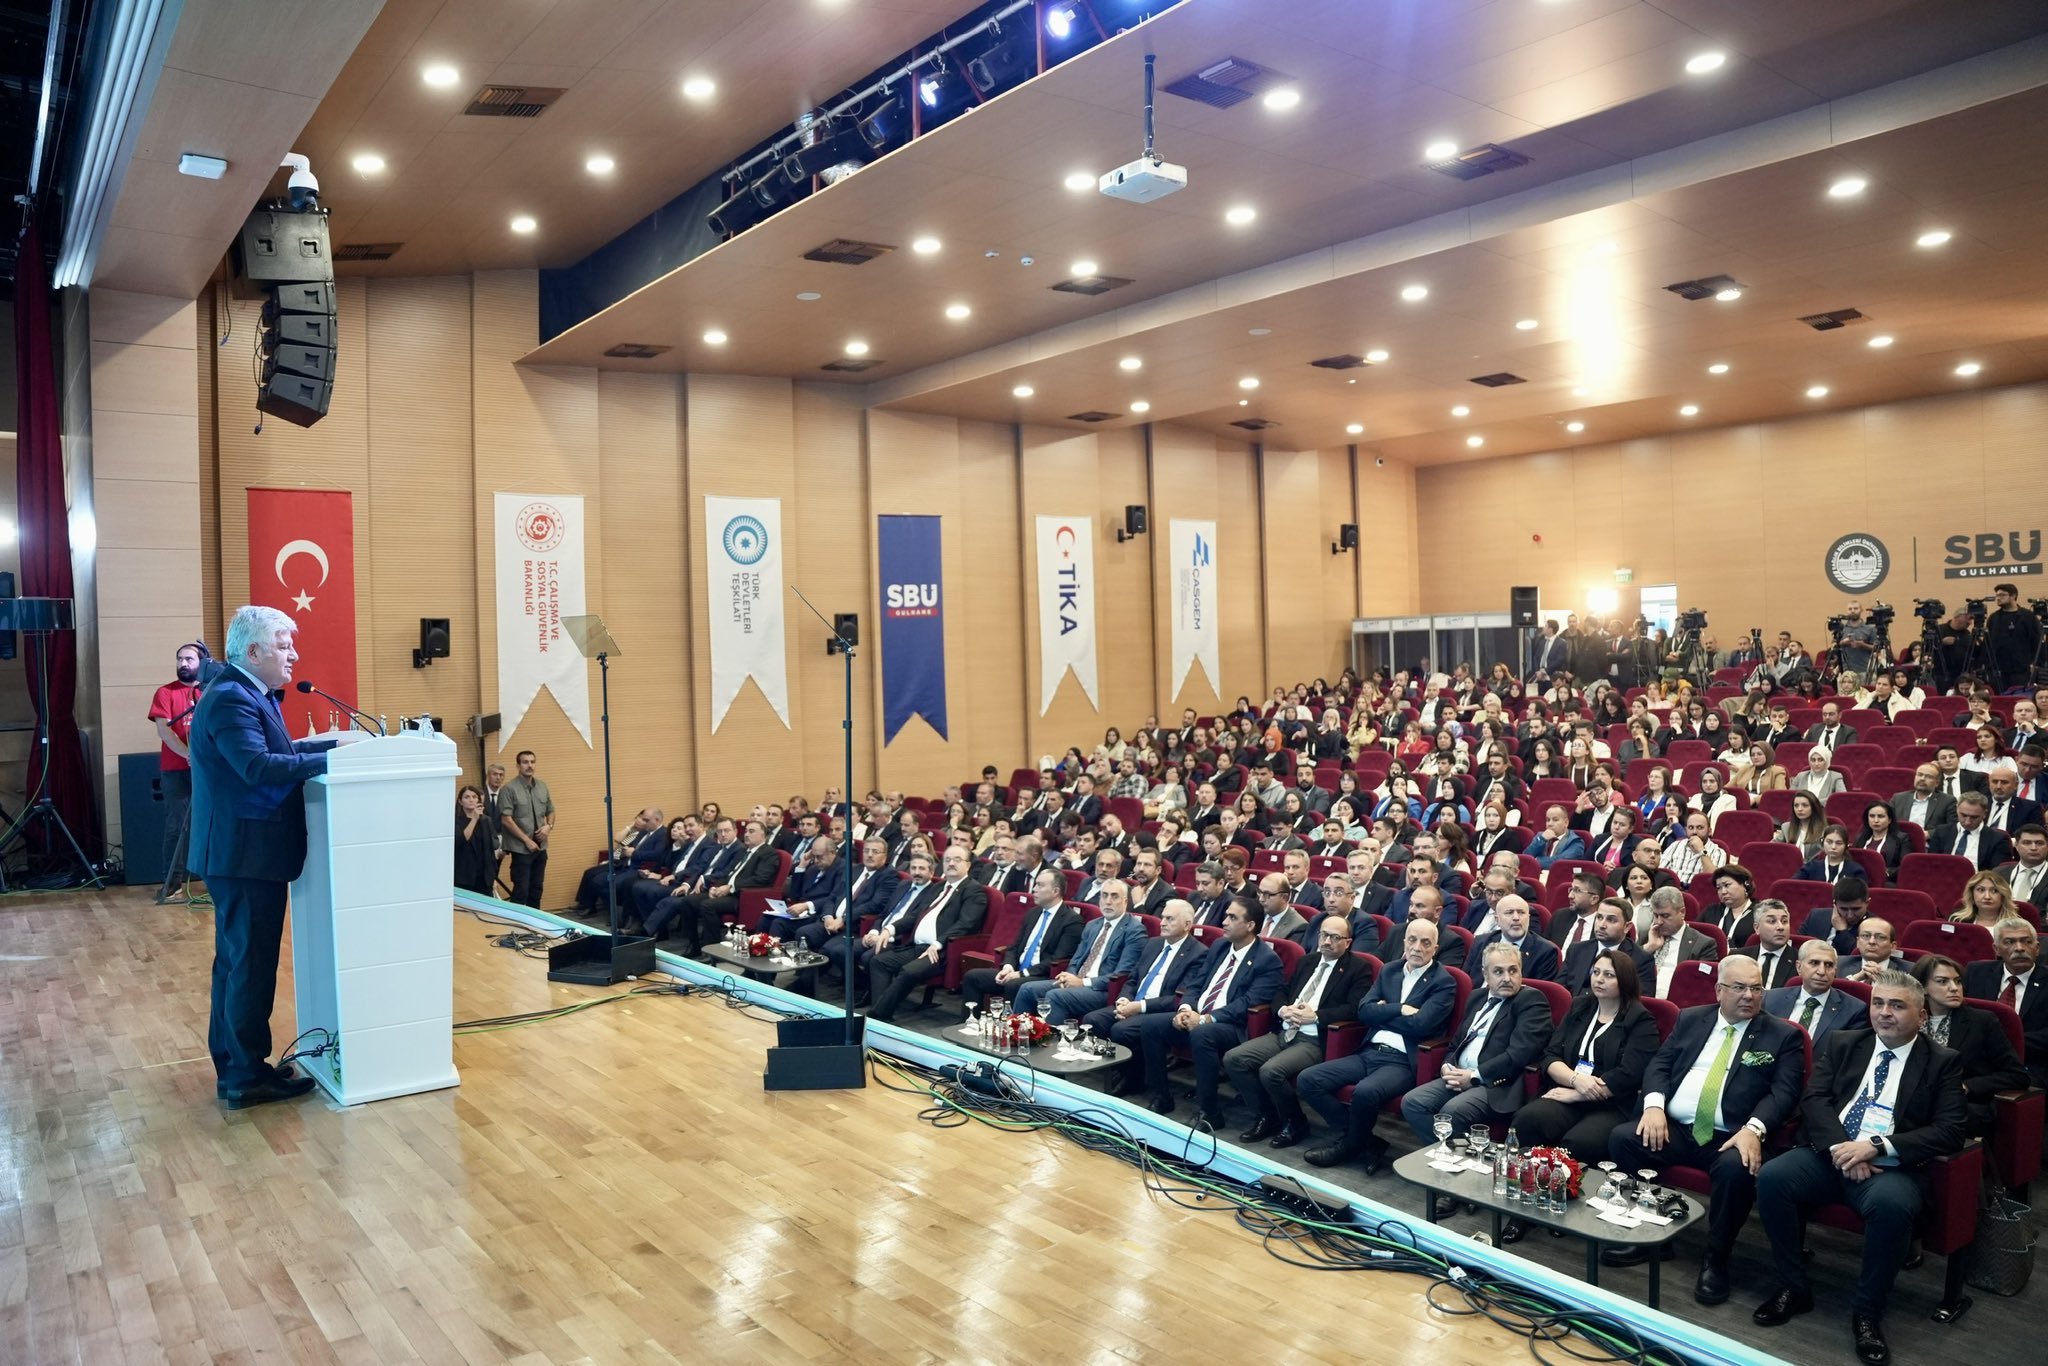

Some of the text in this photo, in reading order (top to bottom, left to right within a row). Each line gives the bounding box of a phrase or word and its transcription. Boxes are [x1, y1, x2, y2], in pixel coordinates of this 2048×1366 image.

[524, 560, 535, 616] BAKANLIĞI
[731, 572, 742, 623] TEŞKİLATI
[751, 572, 760, 600] TÜRK
[1058, 563, 1080, 636] TİKA
[1960, 565, 2029, 577] GULHANE
[537, 561, 549, 653] SOSYAL GÜVENLİK
[548, 561, 559, 640] T.C. ÇALIŞMA VE
[742, 573, 753, 634] DEVLETLERİ
